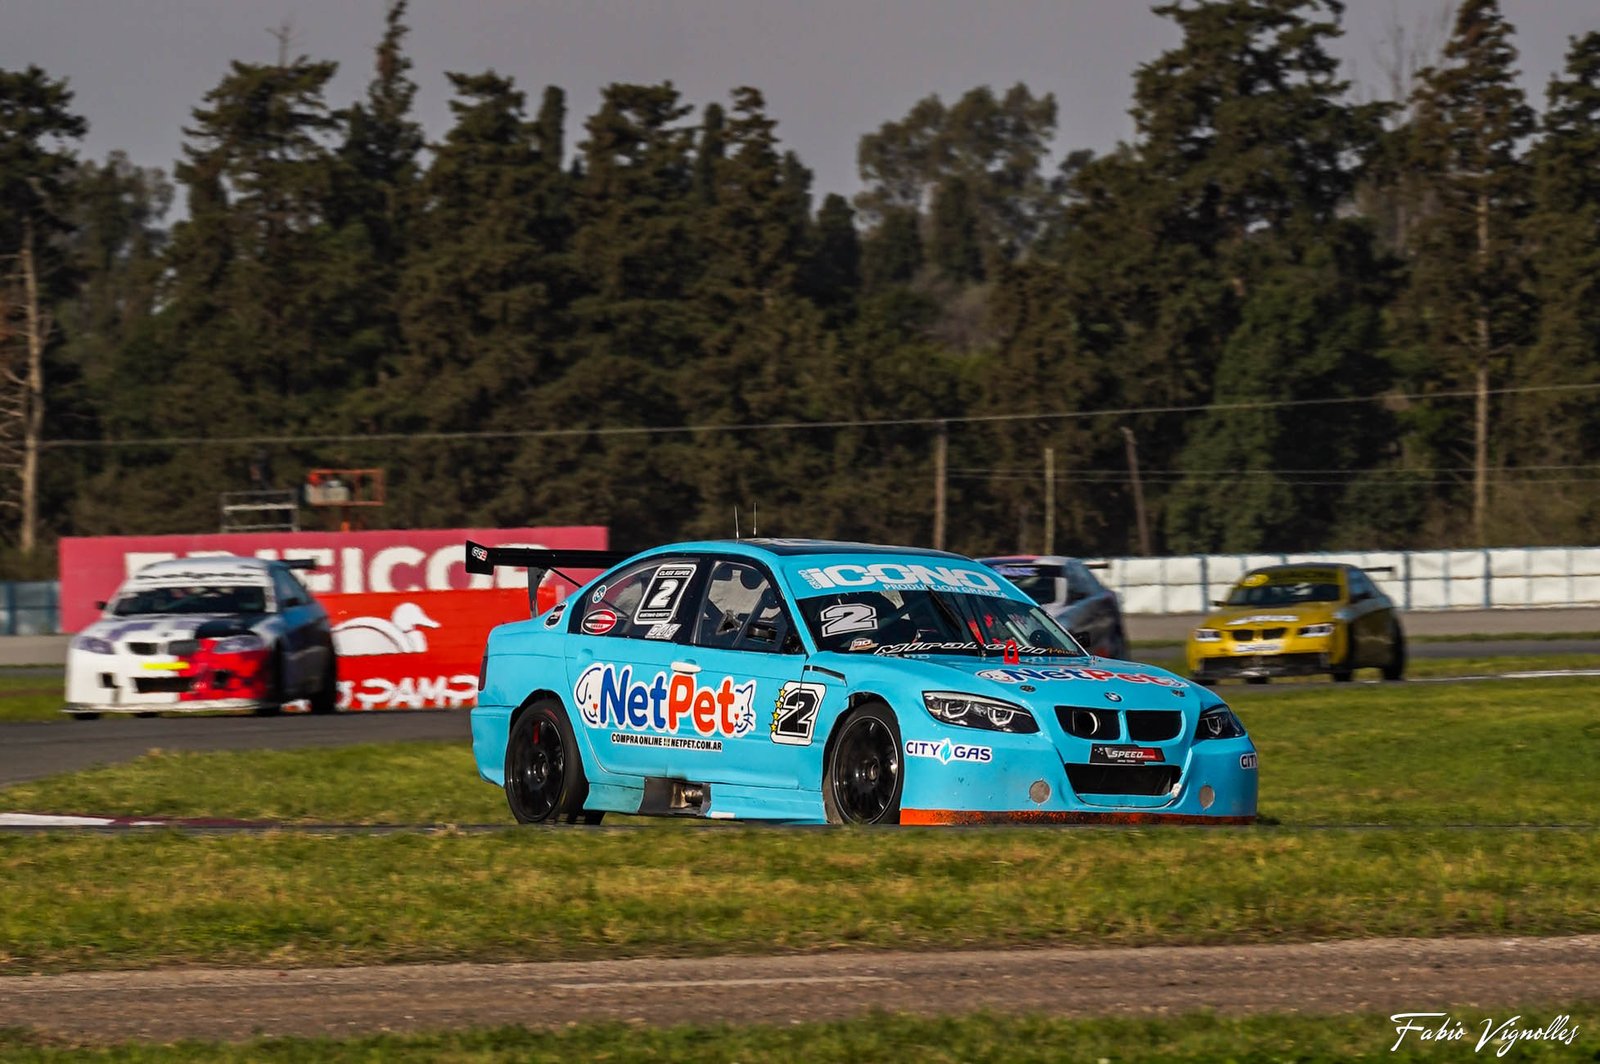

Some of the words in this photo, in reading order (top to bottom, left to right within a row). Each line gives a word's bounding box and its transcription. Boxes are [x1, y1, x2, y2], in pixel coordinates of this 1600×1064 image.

[647, 579, 678, 609] 2
[820, 603, 879, 638] 2
[1007, 667, 1170, 686] NetPet
[599, 666, 735, 734] NetPet
[777, 687, 819, 738] 2
[612, 733, 639, 744] COMPRA
[639, 735, 663, 747] ONLINE
[671, 738, 722, 751] NETPET.COM.AR
[905, 740, 940, 756] CITY
[953, 747, 991, 761] GAS
[1112, 750, 1144, 759] SPEED
